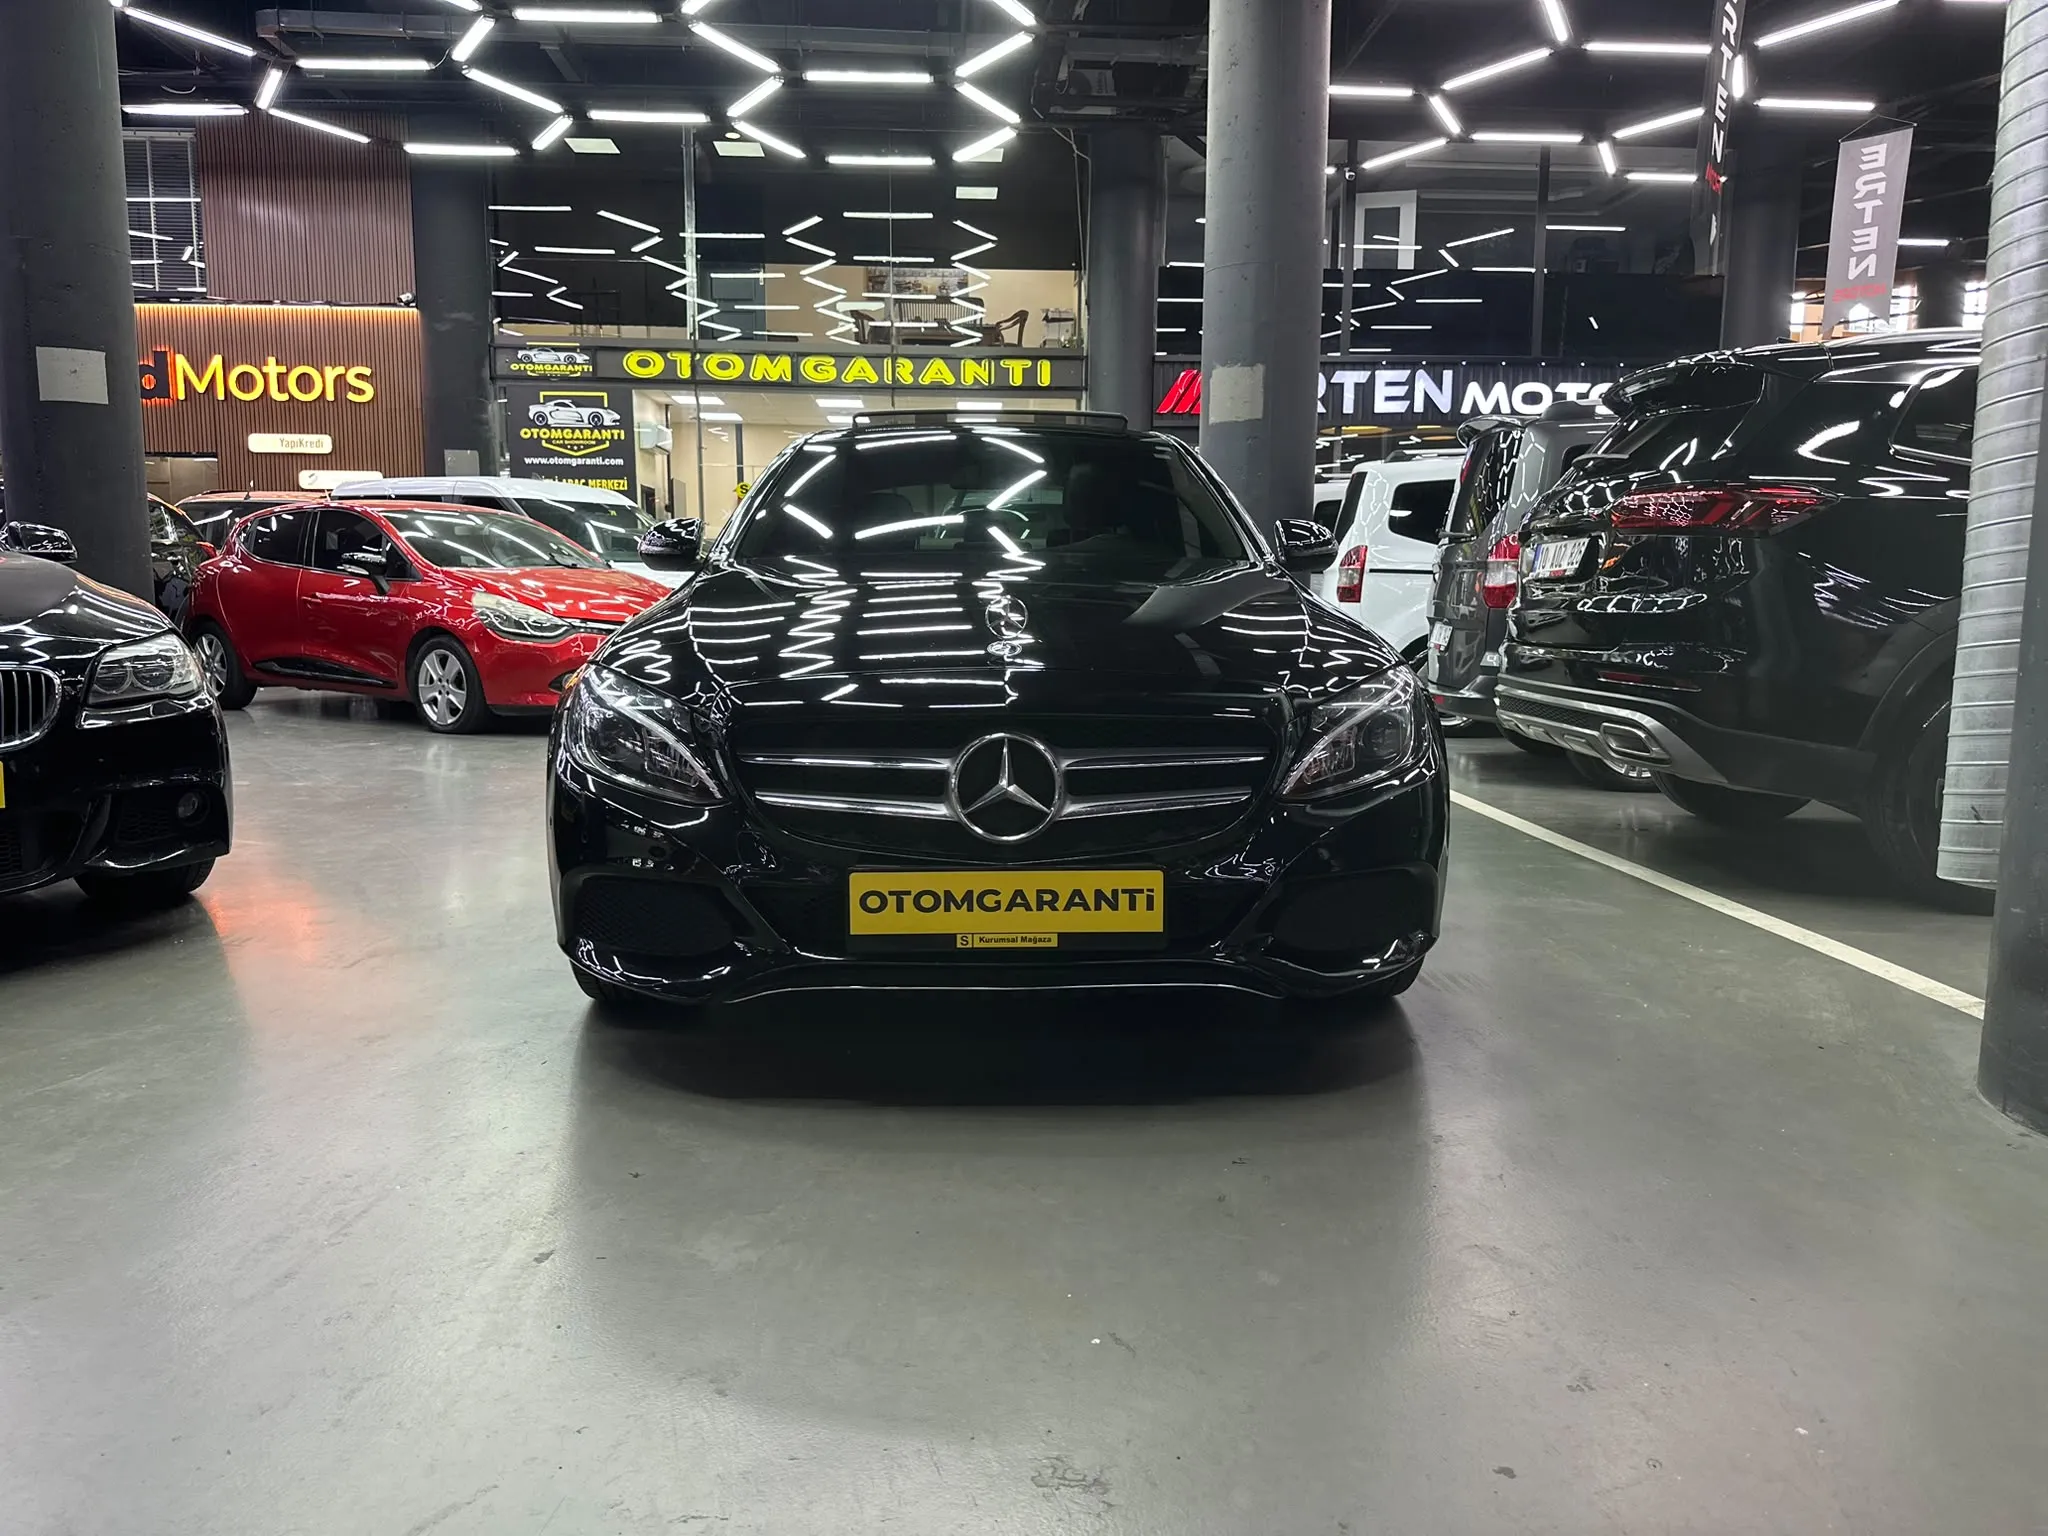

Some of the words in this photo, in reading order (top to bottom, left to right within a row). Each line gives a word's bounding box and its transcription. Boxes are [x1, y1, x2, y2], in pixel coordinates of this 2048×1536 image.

[1712, 0, 1738, 163] RTEN
[510, 363, 593, 372] OTOMGARANTI
[622, 350, 1050, 387] OTOMGARANTI
[520, 428, 625, 440] OTOMGARANTI
[524, 456, 624, 467] www.otomgaranti.com
[960, 935, 969, 946] S
[979, 936, 1018, 944] Kurumsal
[1020, 935, 1052, 945] Mağaza
